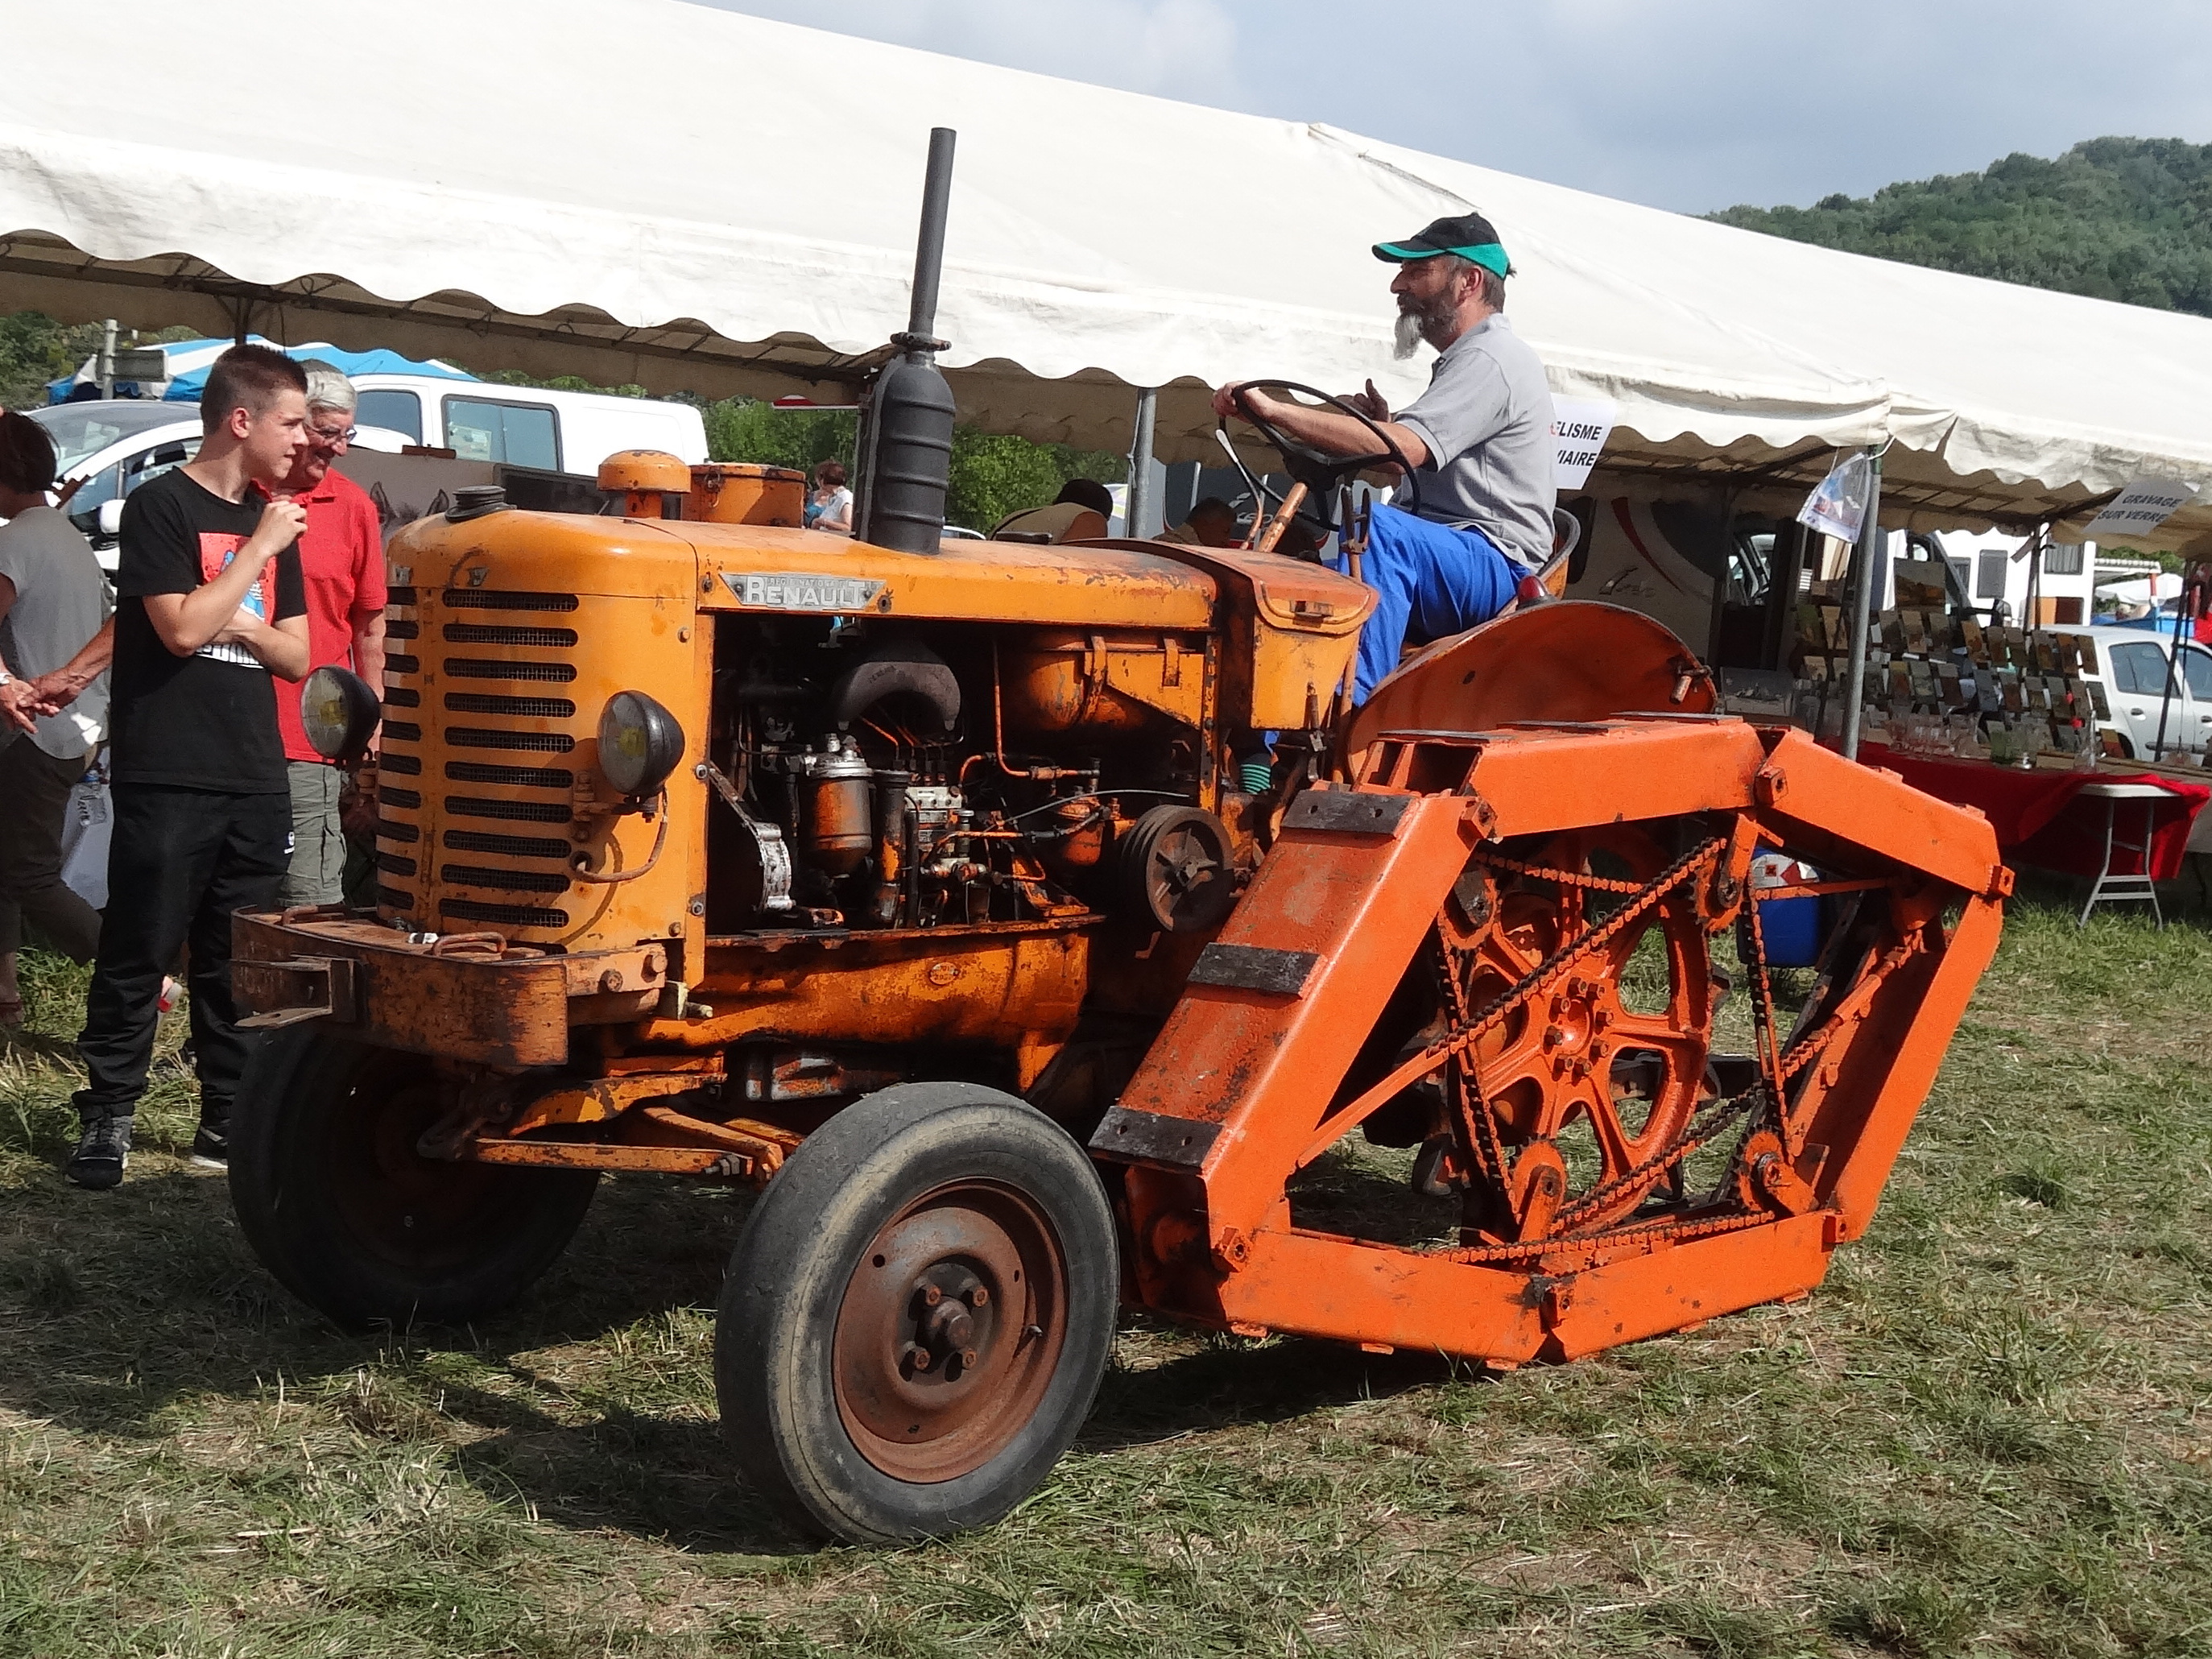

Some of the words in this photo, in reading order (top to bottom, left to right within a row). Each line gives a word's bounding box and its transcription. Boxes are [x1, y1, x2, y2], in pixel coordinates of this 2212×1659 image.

[2122, 494, 2183, 507] GRAVAGE
[2097, 510, 2125, 519] SUR
[2126, 510, 2169, 523] VERRE
[746, 576, 866, 606] RENAULT
